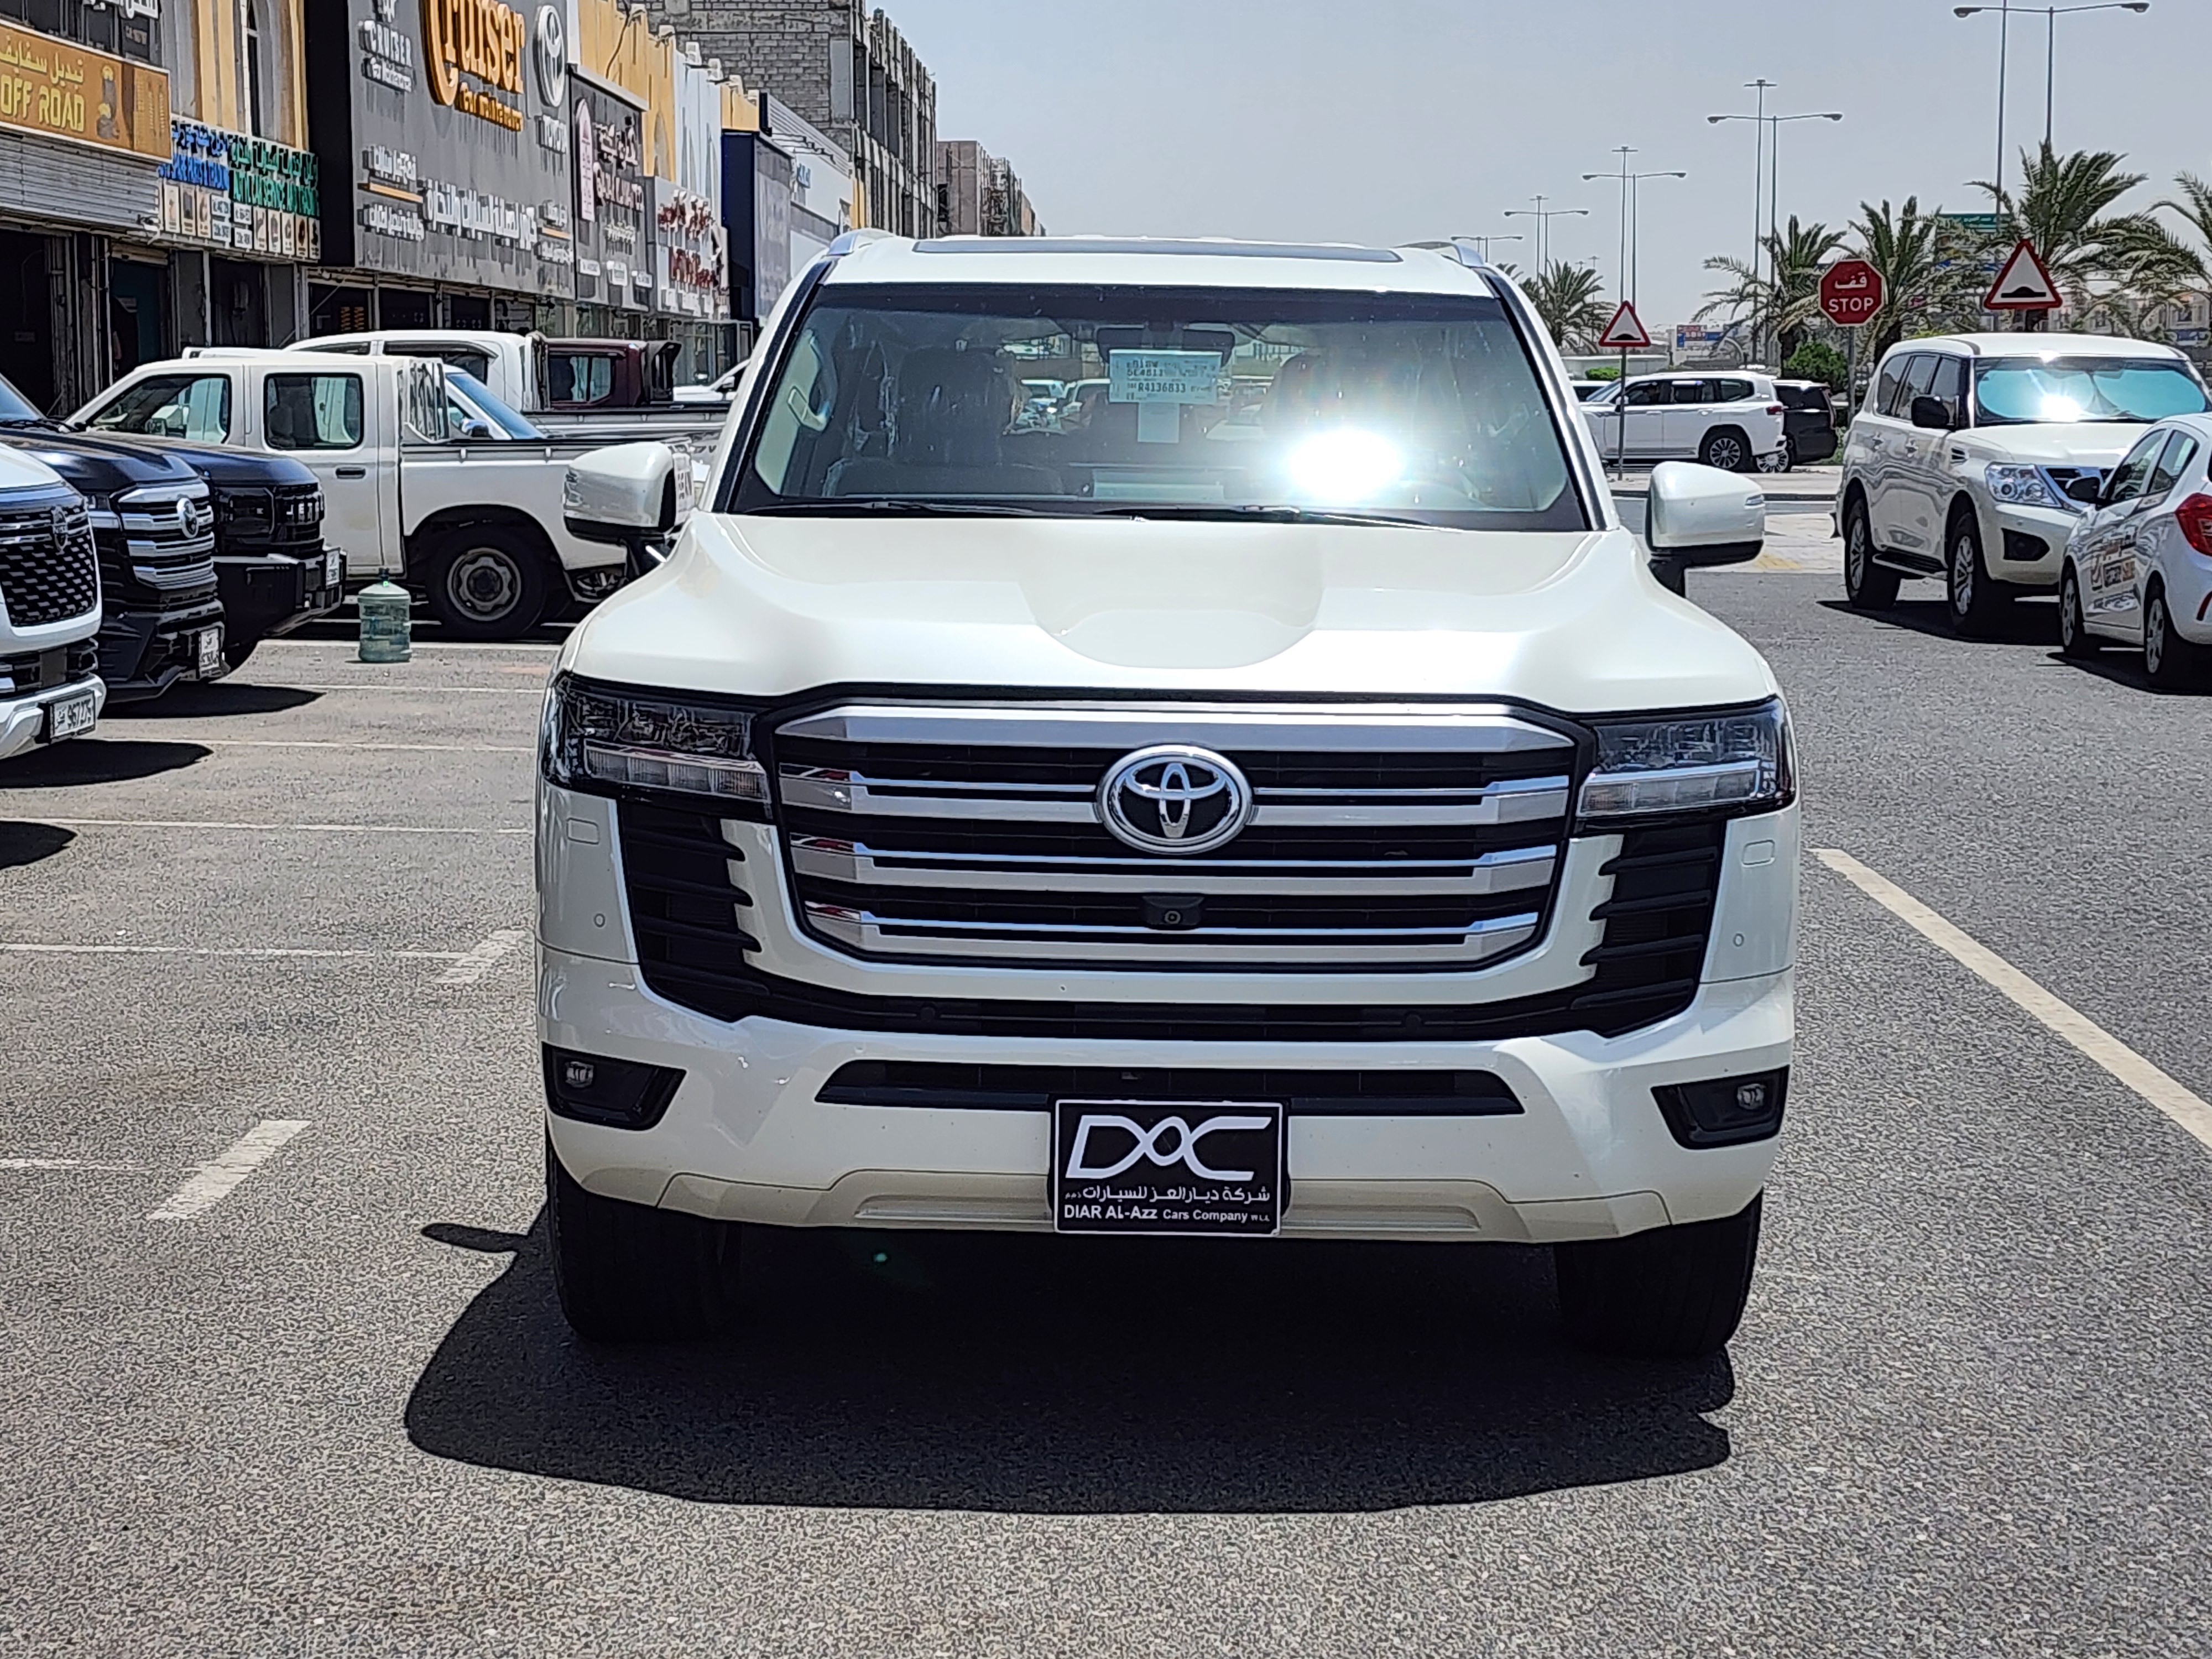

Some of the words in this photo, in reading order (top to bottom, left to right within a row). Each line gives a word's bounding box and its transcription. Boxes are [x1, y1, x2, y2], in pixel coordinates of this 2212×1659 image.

[1, 74, 33, 119] OFF
[38, 85, 85, 132] ROAD
[1834, 272, 1867, 289] قف
[1828, 297, 1874, 313] STOP
[1082, 1185, 1147, 1203] للسيارات
[1222, 1186, 1270, 1204] شركة
[1064, 1204, 1102, 1219] DIAR
[1162, 1209, 1190, 1220] Cars
[1192, 1209, 1248, 1224] Company
